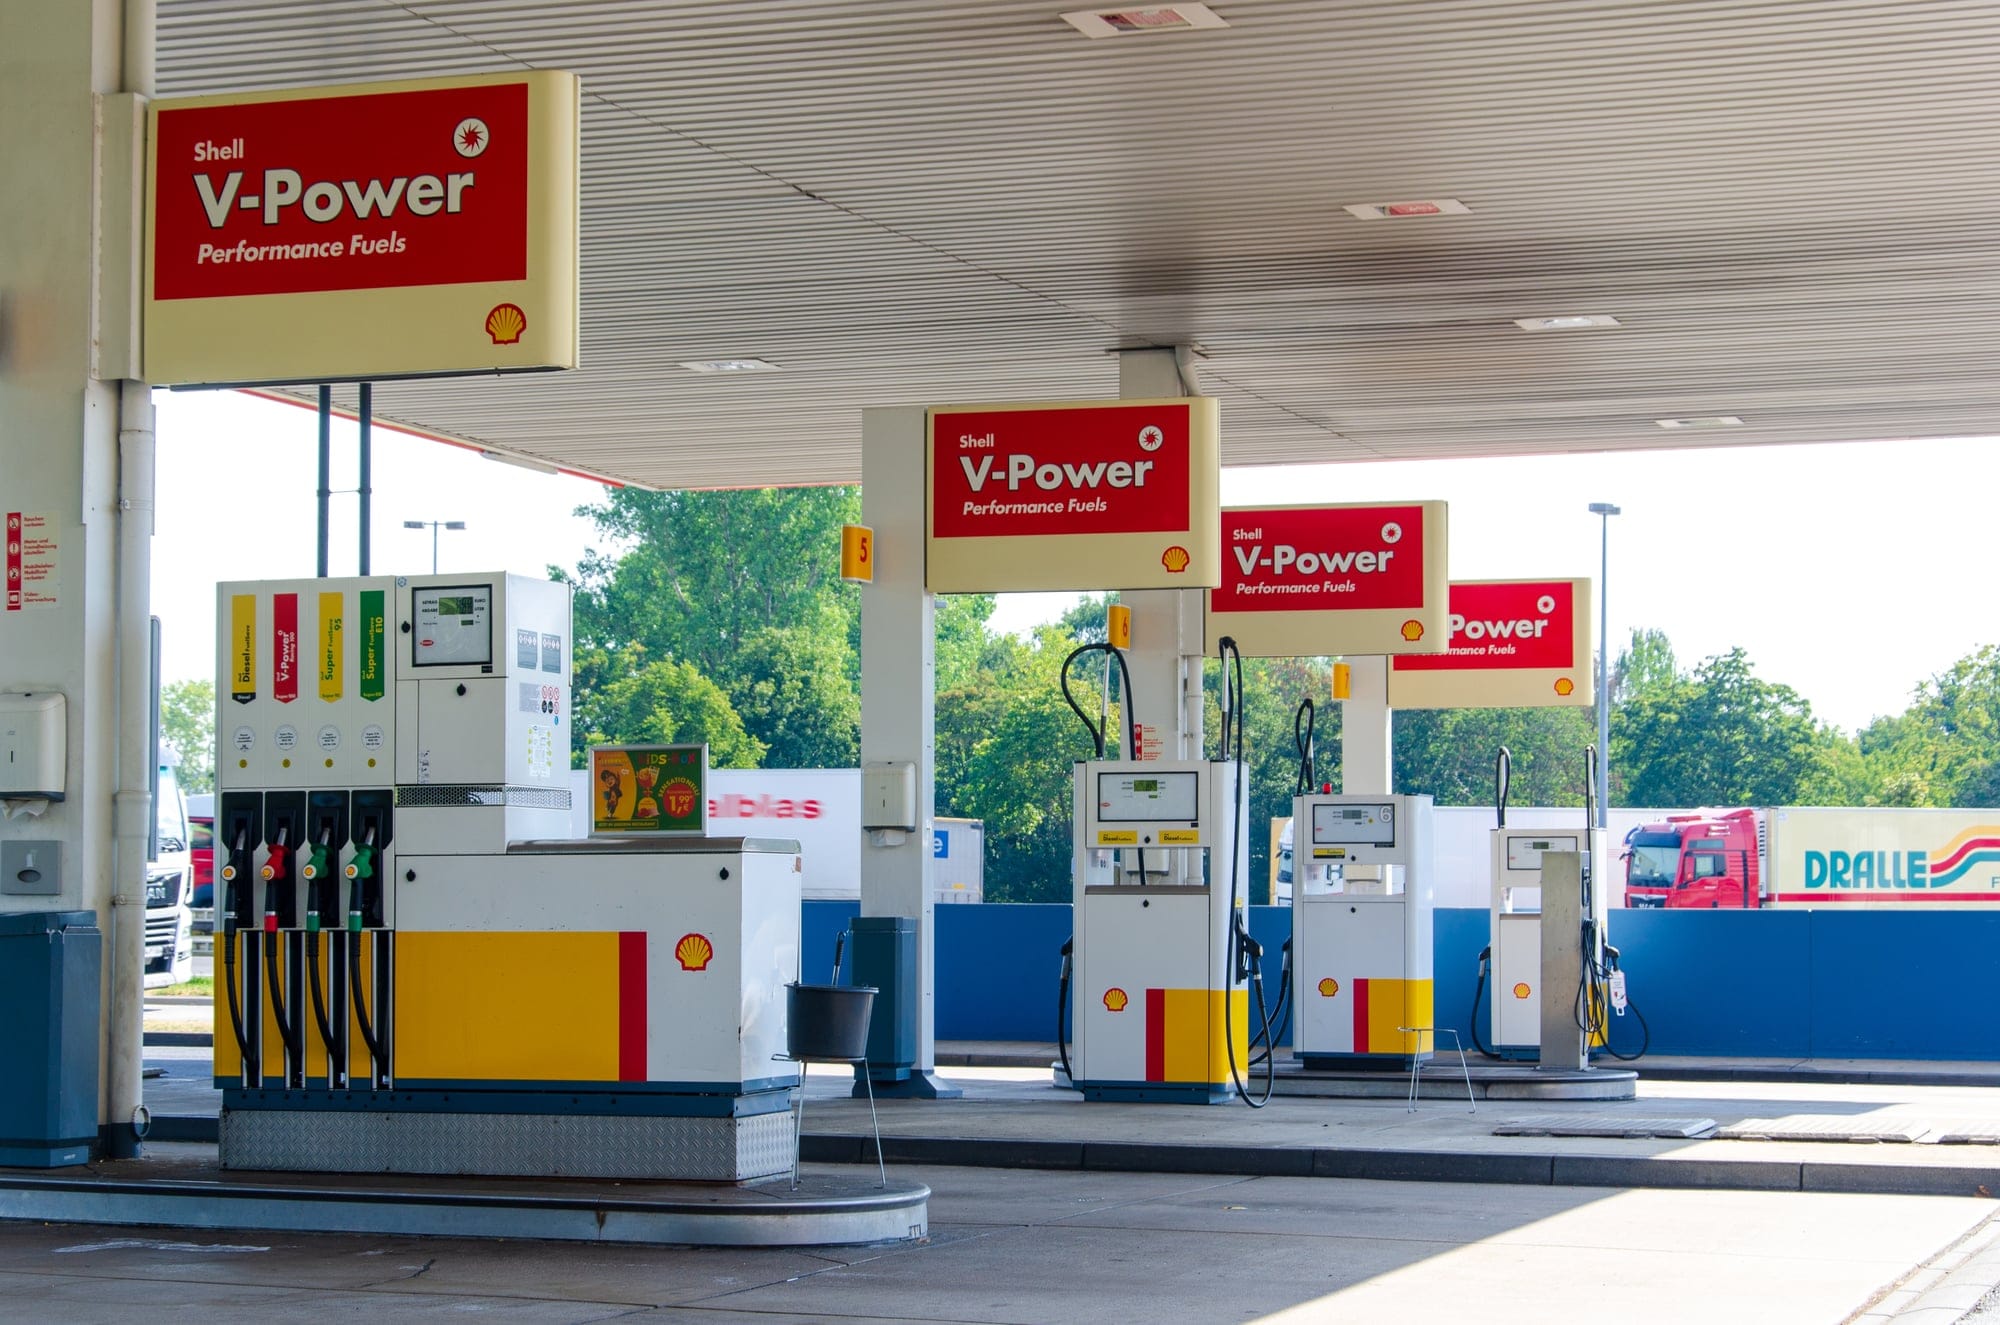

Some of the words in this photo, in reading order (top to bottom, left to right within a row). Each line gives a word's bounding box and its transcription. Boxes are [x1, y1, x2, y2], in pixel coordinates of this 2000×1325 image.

[194, 138, 244, 162] Shell
[192, 168, 475, 229] V-Power
[197, 239, 344, 264] Performance
[349, 230, 406, 255] Fuels
[959, 433, 994, 448] Shell
[958, 453, 1154, 492] V-Power
[963, 499, 1064, 515] Performance
[1068, 496, 1107, 512] Fuels
[1233, 528, 1262, 540] Shell
[860, 537, 867, 562] 5
[1232, 544, 1394, 576] V-Power
[1236, 581, 1320, 595] Performance
[1323, 580, 1355, 593] Fuels
[334, 618, 342, 631] 95
[375, 617, 383, 633] E10
[1122, 616, 1128, 637] 6
[1447, 613, 1548, 640] Power
[281, 631, 290, 681] V-Power
[1488, 644, 1516, 655] Fuels
[242, 652, 250, 682] Diesel
[325, 648, 335, 680] Super
[366, 647, 376, 679] Super
[1380, 806, 1392, 824] 6
[1805, 850, 1927, 888] DRALLE
[147, 887, 166, 899] AN
